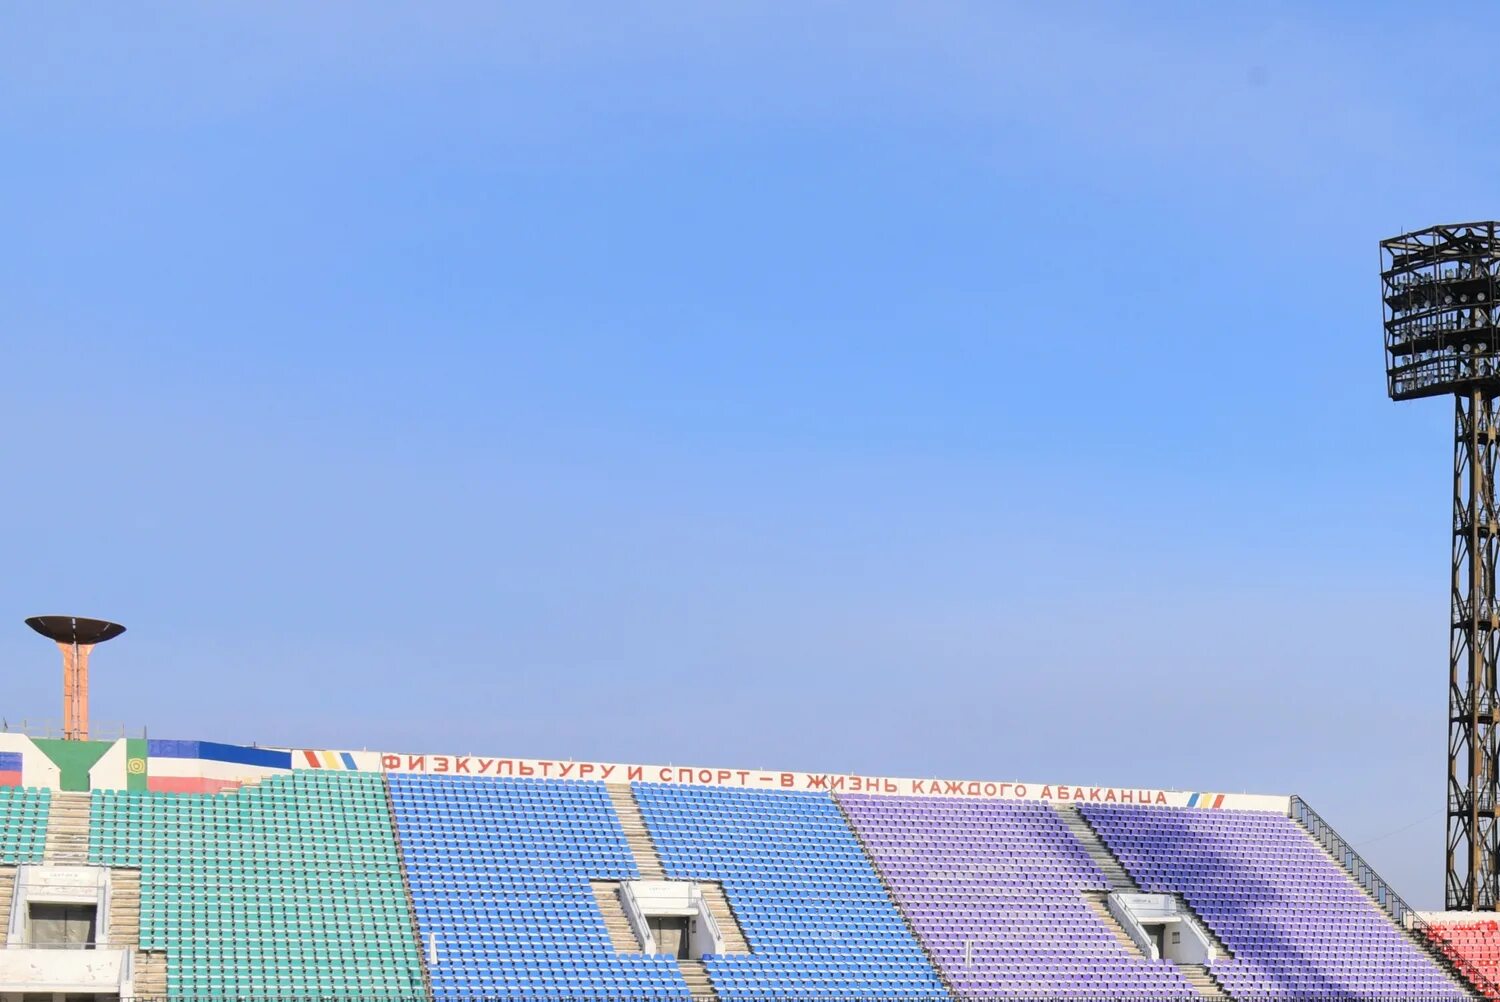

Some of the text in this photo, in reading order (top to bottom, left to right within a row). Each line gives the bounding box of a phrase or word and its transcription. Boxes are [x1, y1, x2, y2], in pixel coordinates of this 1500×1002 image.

[382, 753, 616, 780] ФИЗКУЛЬТУРУ
[627, 766, 643, 781] И
[660, 767, 749, 786] СПОРТ
[781, 773, 795, 788] В
[806, 774, 898, 793] ЖИЗНЬ
[912, 780, 1027, 799] КАЖДОГО
[1040, 784, 1169, 805] АБАКАНЦА
